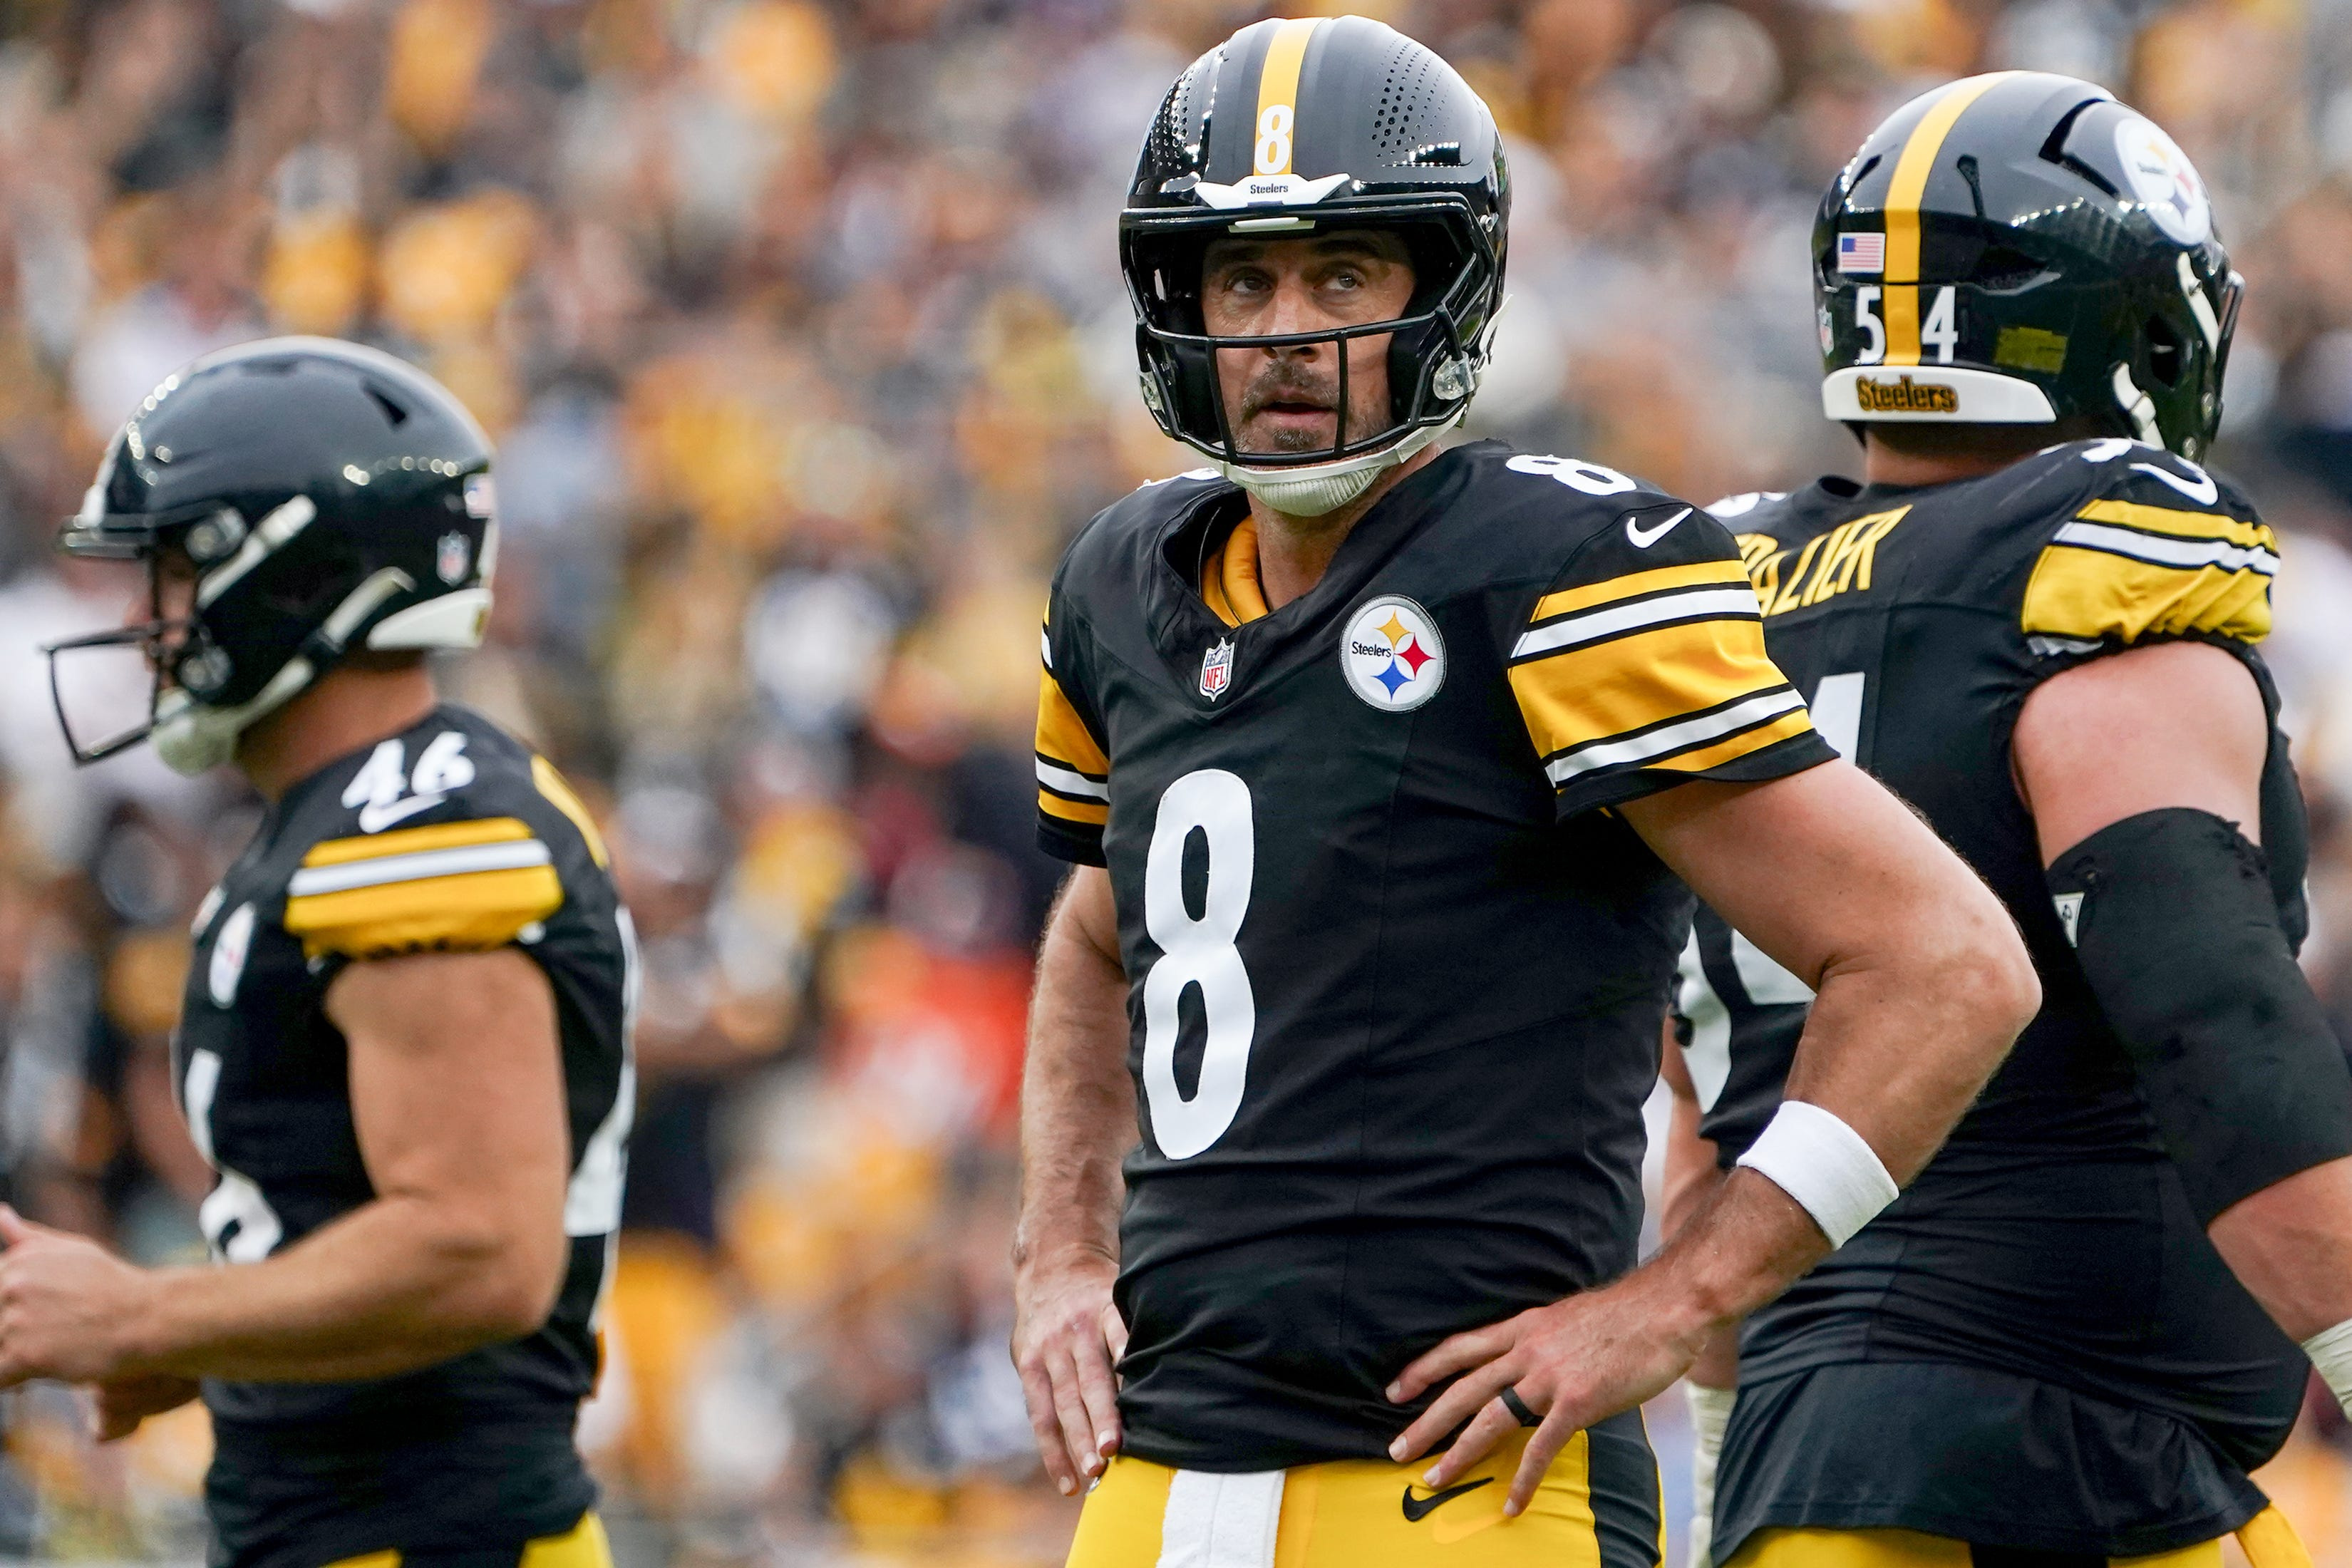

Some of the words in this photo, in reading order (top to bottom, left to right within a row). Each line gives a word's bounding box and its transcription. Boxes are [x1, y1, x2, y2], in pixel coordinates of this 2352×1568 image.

[1255, 104, 1294, 175] 8
[1250, 183, 1289, 195] Steelers
[1856, 374, 1959, 412] Steelers
[1505, 454, 1637, 496] 8
[1735, 503, 1914, 619] RAZIER
[1351, 641, 1392, 659] Steelers
[1205, 666, 1225, 690] NFL
[341, 731, 475, 809] 46
[1143, 768, 1255, 1160] 8
